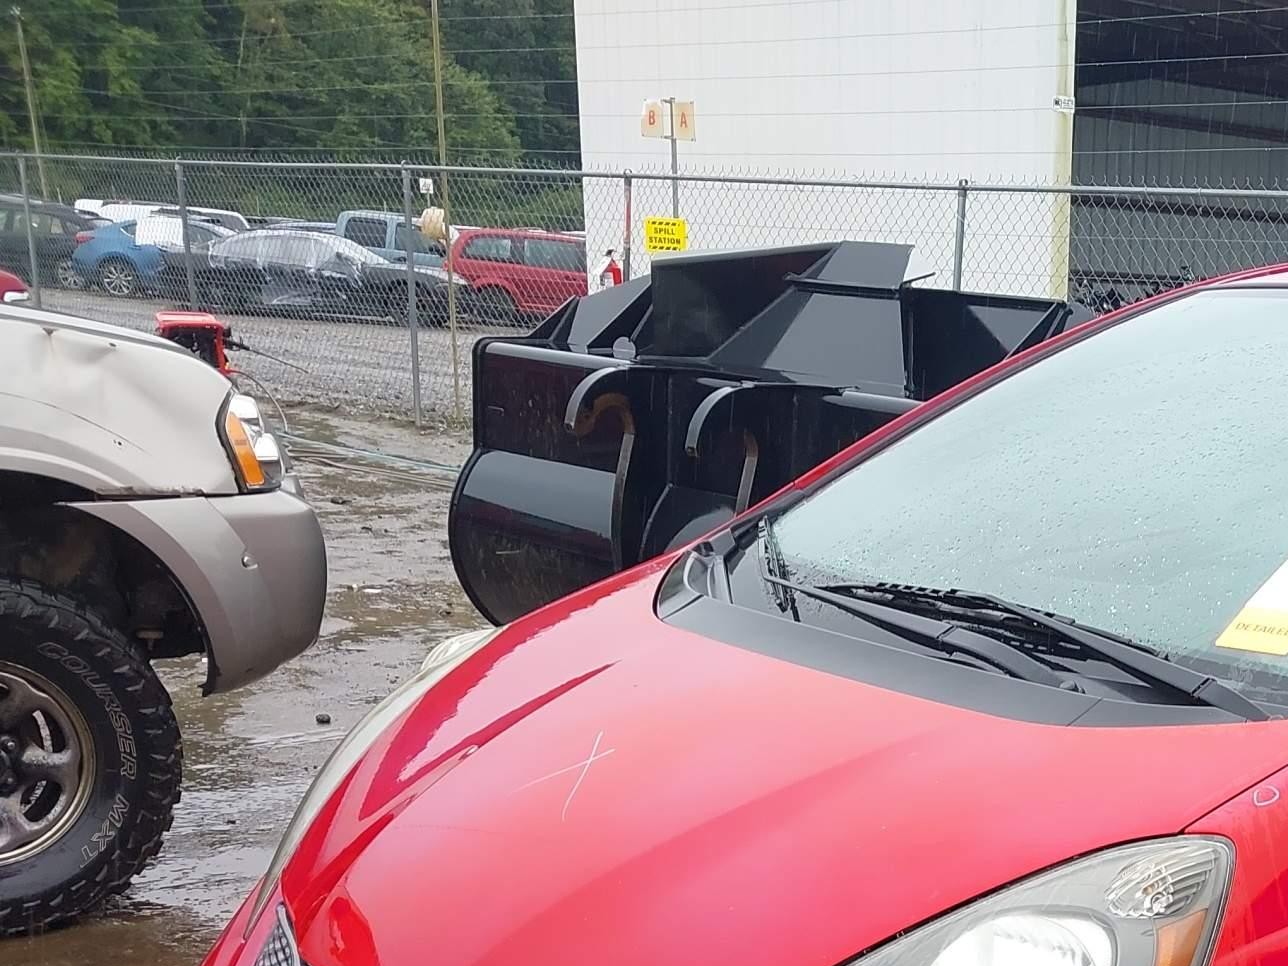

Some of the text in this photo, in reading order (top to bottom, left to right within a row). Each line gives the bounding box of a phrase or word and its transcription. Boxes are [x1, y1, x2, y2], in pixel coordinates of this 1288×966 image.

[648, 110, 656, 126] B
[679, 111, 688, 128] A
[653, 227, 676, 236] SPILL
[648, 236, 681, 246] STATION
[37, 641, 138, 869] COURSER MXT
